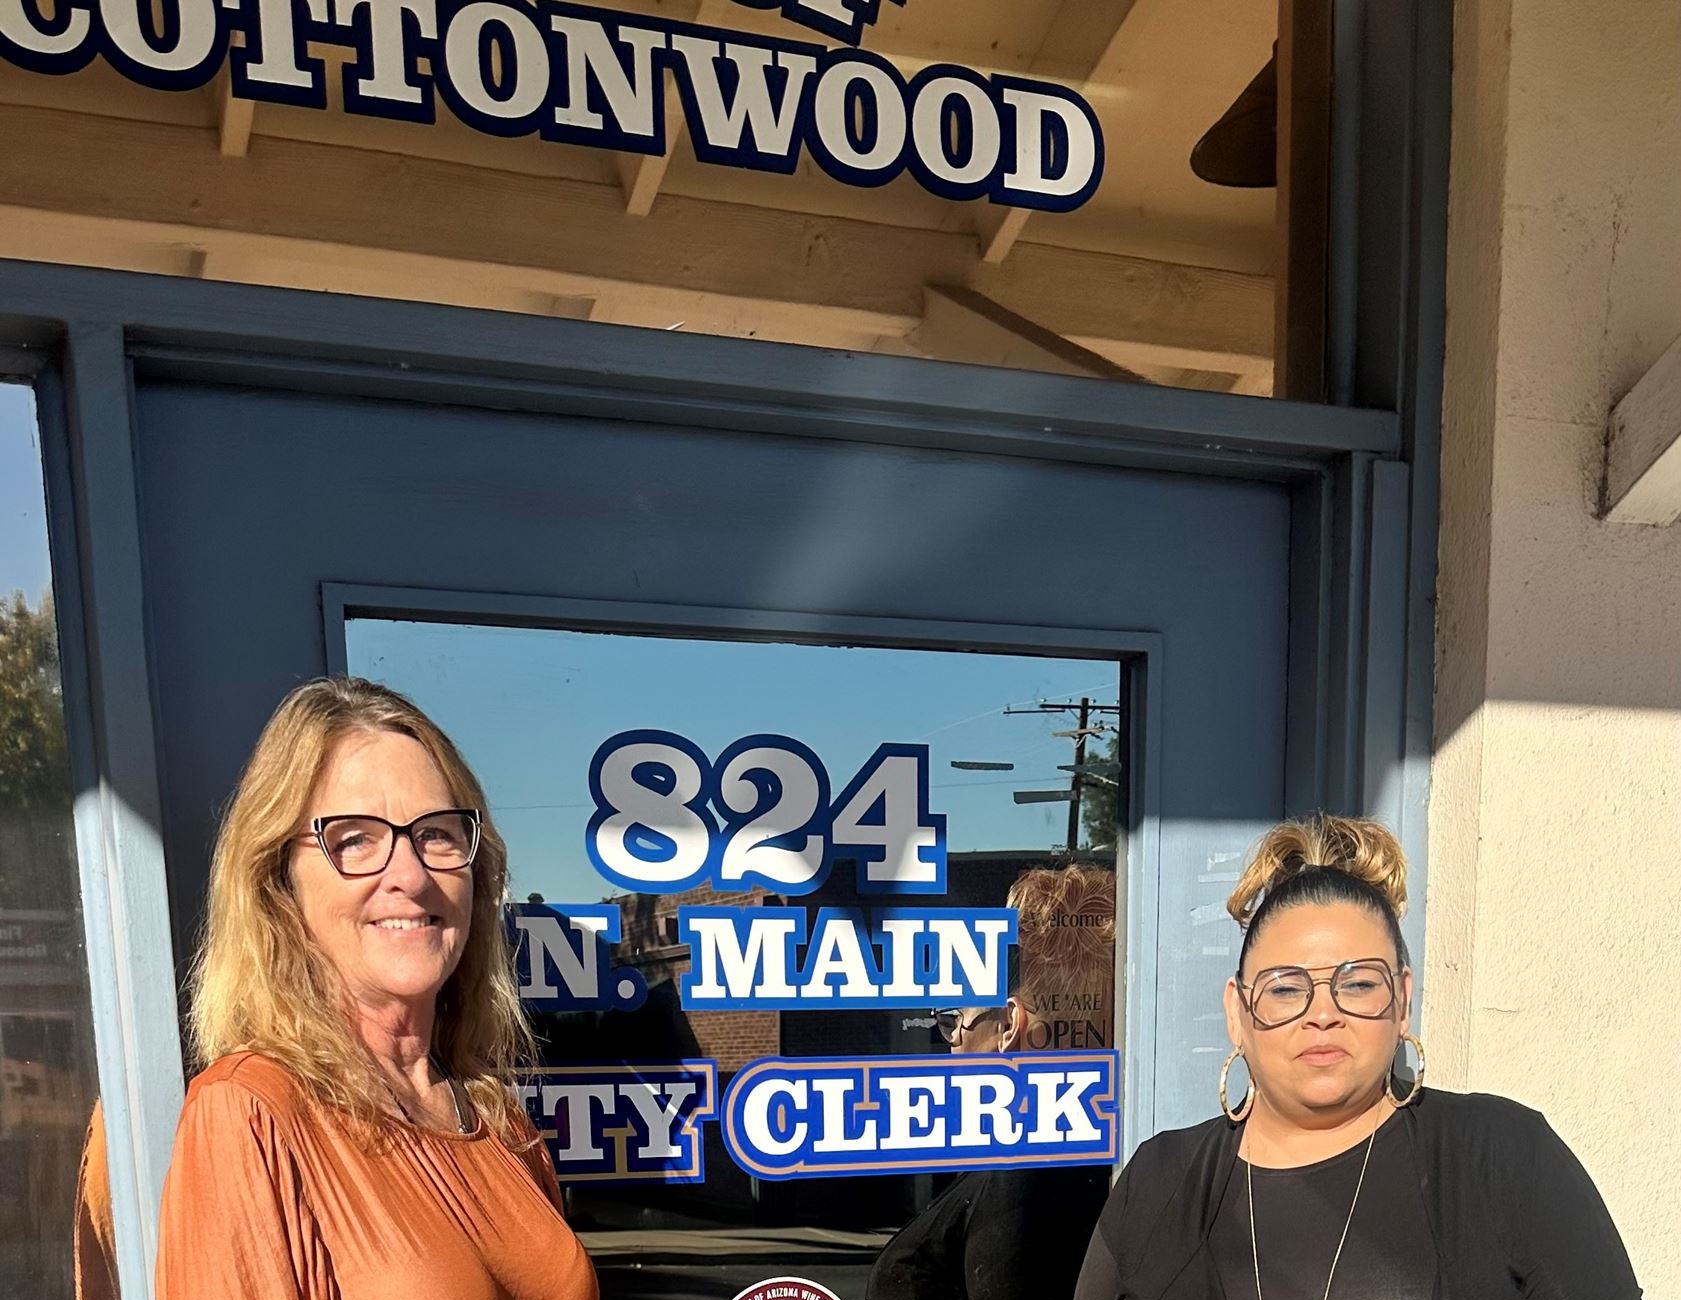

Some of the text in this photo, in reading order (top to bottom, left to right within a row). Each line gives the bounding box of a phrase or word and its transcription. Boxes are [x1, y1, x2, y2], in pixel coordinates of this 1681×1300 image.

[596, 743, 936, 883] 824
[516, 916, 1008, 998] N. MAIN
[1033, 994, 1060, 1012] WE
[1026, 1020, 1106, 1049] OPEN
[744, 1072, 1102, 1156] CLERK
[767, 1288, 798, 1300] ARIZONA
